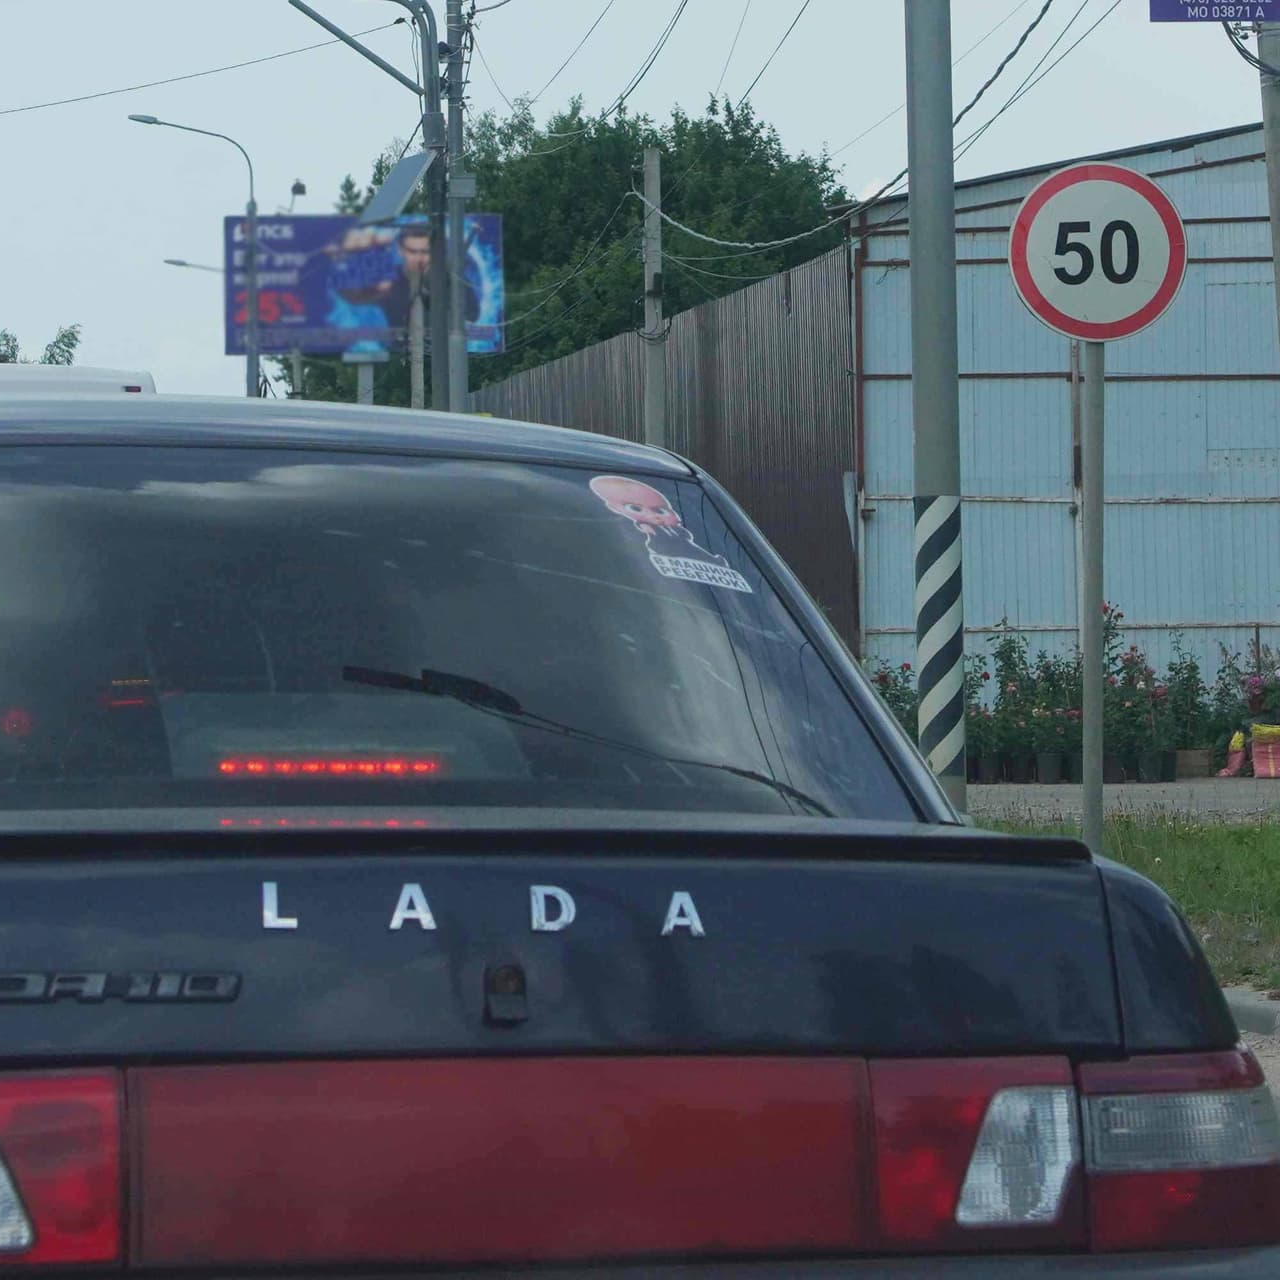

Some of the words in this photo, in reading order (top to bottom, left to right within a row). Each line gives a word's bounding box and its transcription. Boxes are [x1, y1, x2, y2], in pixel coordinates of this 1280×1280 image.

[1187, 6, 1208, 18] МО
[1212, 6, 1251, 18] 03871
[1053, 219, 1140, 286] 50
[261, 880, 706, 936] LADA
